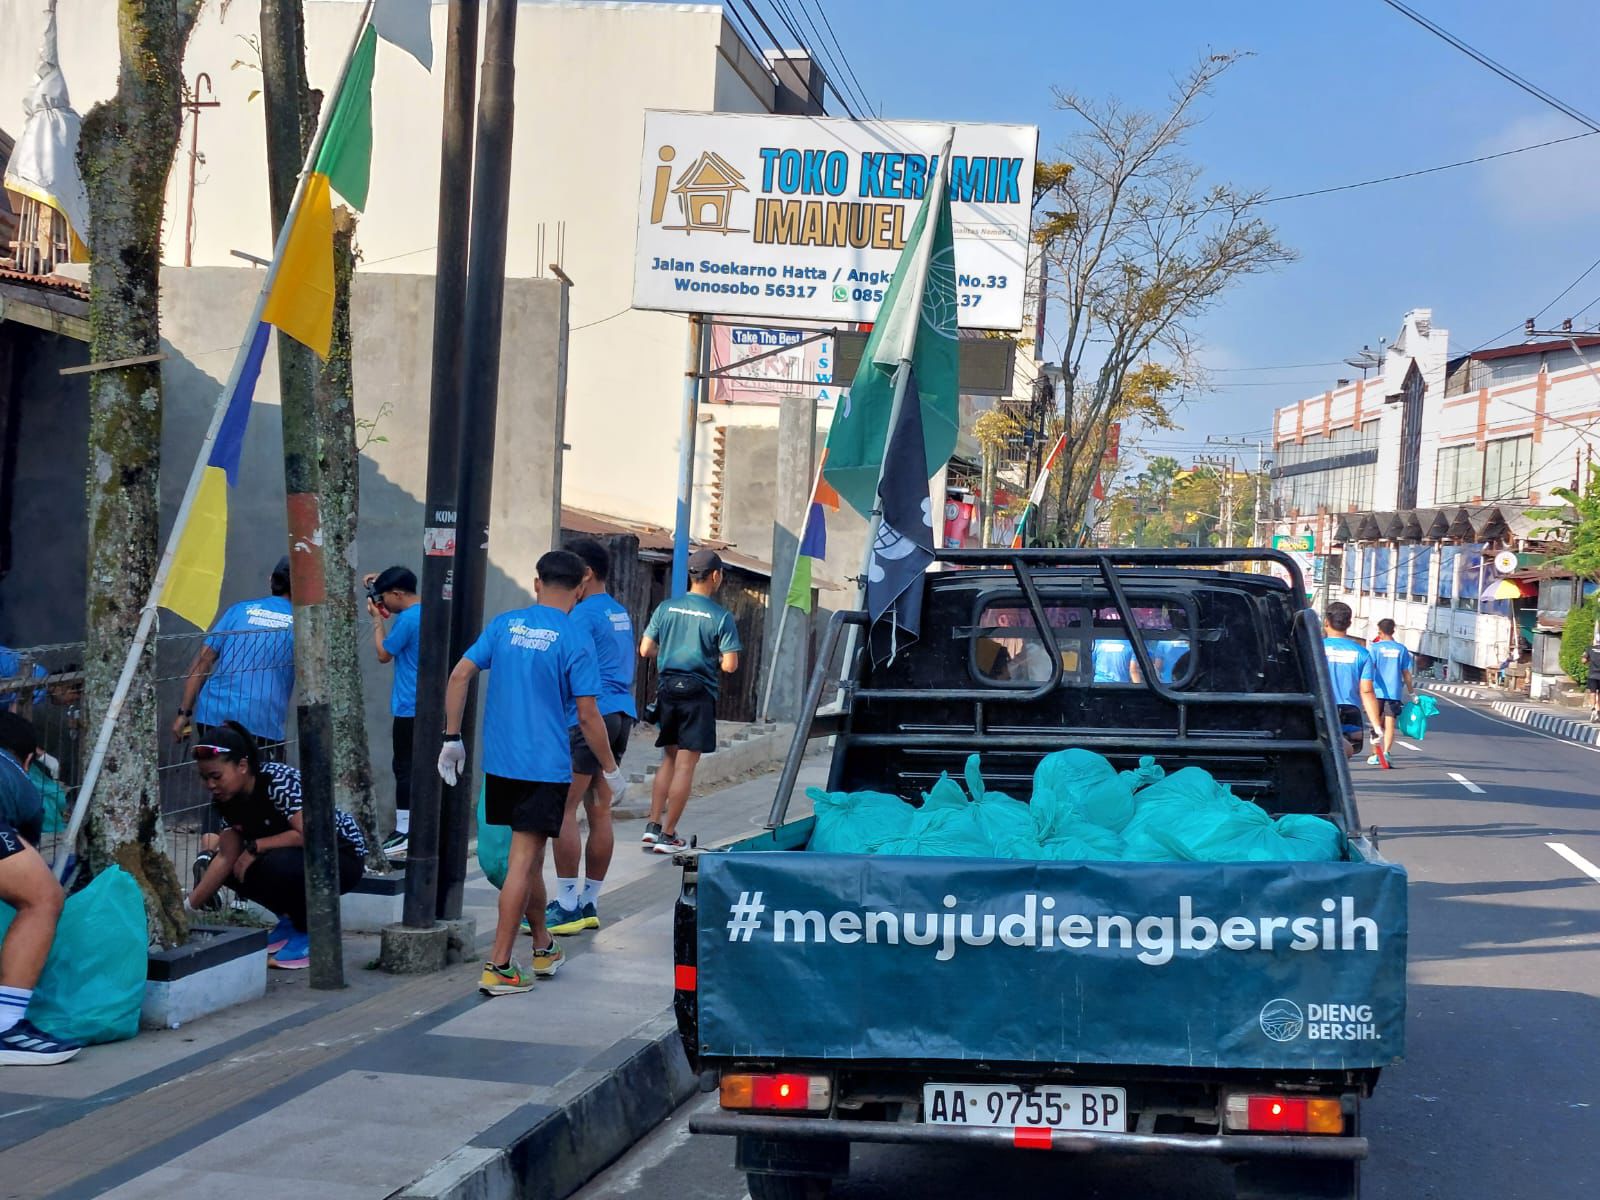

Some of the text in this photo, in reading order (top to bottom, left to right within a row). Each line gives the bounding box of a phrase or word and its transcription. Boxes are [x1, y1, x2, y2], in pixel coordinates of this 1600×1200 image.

[759, 148, 848, 197] TOKO
[753, 198, 907, 250] IMANUEL
[652, 257, 695, 273] Jalan
[700, 260, 777, 278] Soekarno
[783, 265, 828, 281] Hatta
[832, 268, 842, 283] /
[958, 274, 1008, 289] No.33
[675, 277, 760, 296] Wonosobo
[764, 283, 817, 299] 56317
[736, 330, 800, 345] Take The Best
[726, 891, 1379, 966] #menujudiengbersih
[1307, 1003, 1373, 1022] DIENG
[1308, 1022, 1382, 1041] BERSIH.
[931, 1089, 1119, 1127] AA 9755 BP
